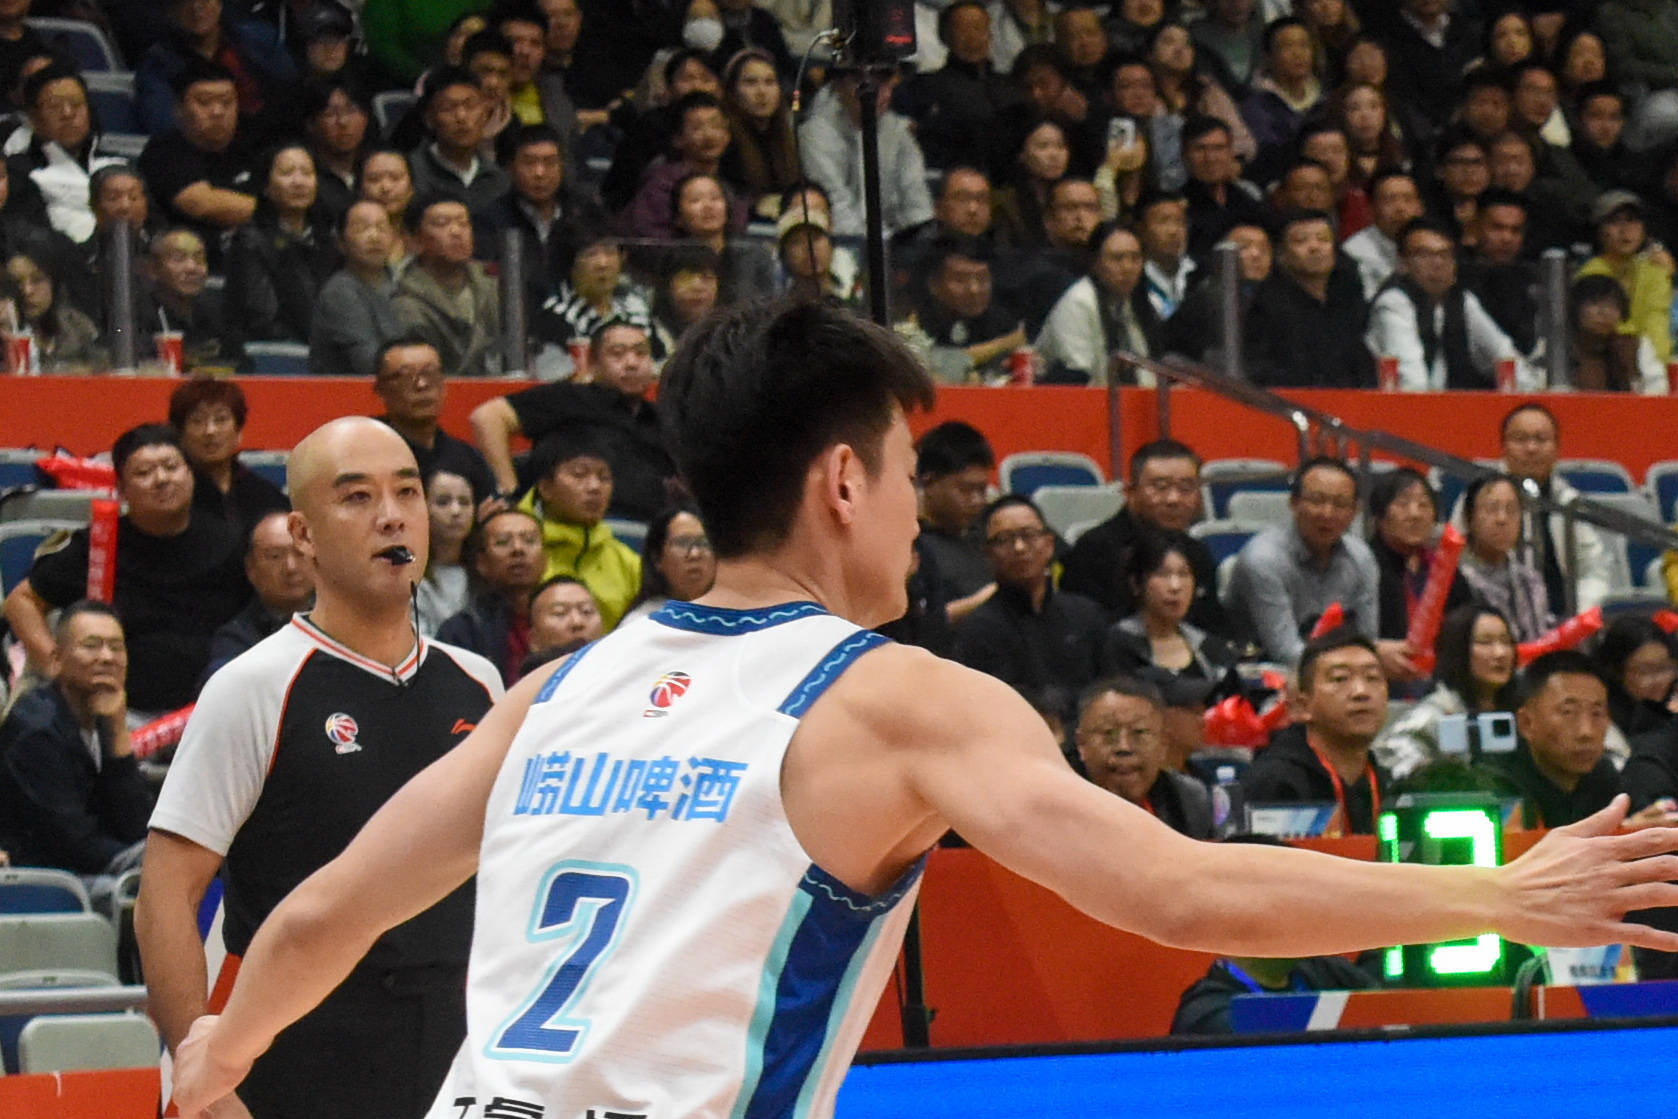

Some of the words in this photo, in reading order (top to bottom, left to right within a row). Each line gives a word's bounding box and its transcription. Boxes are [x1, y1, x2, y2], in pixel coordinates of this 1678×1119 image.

[513, 751, 748, 823] 崂山啤酒
[483, 859, 640, 1064] 2
